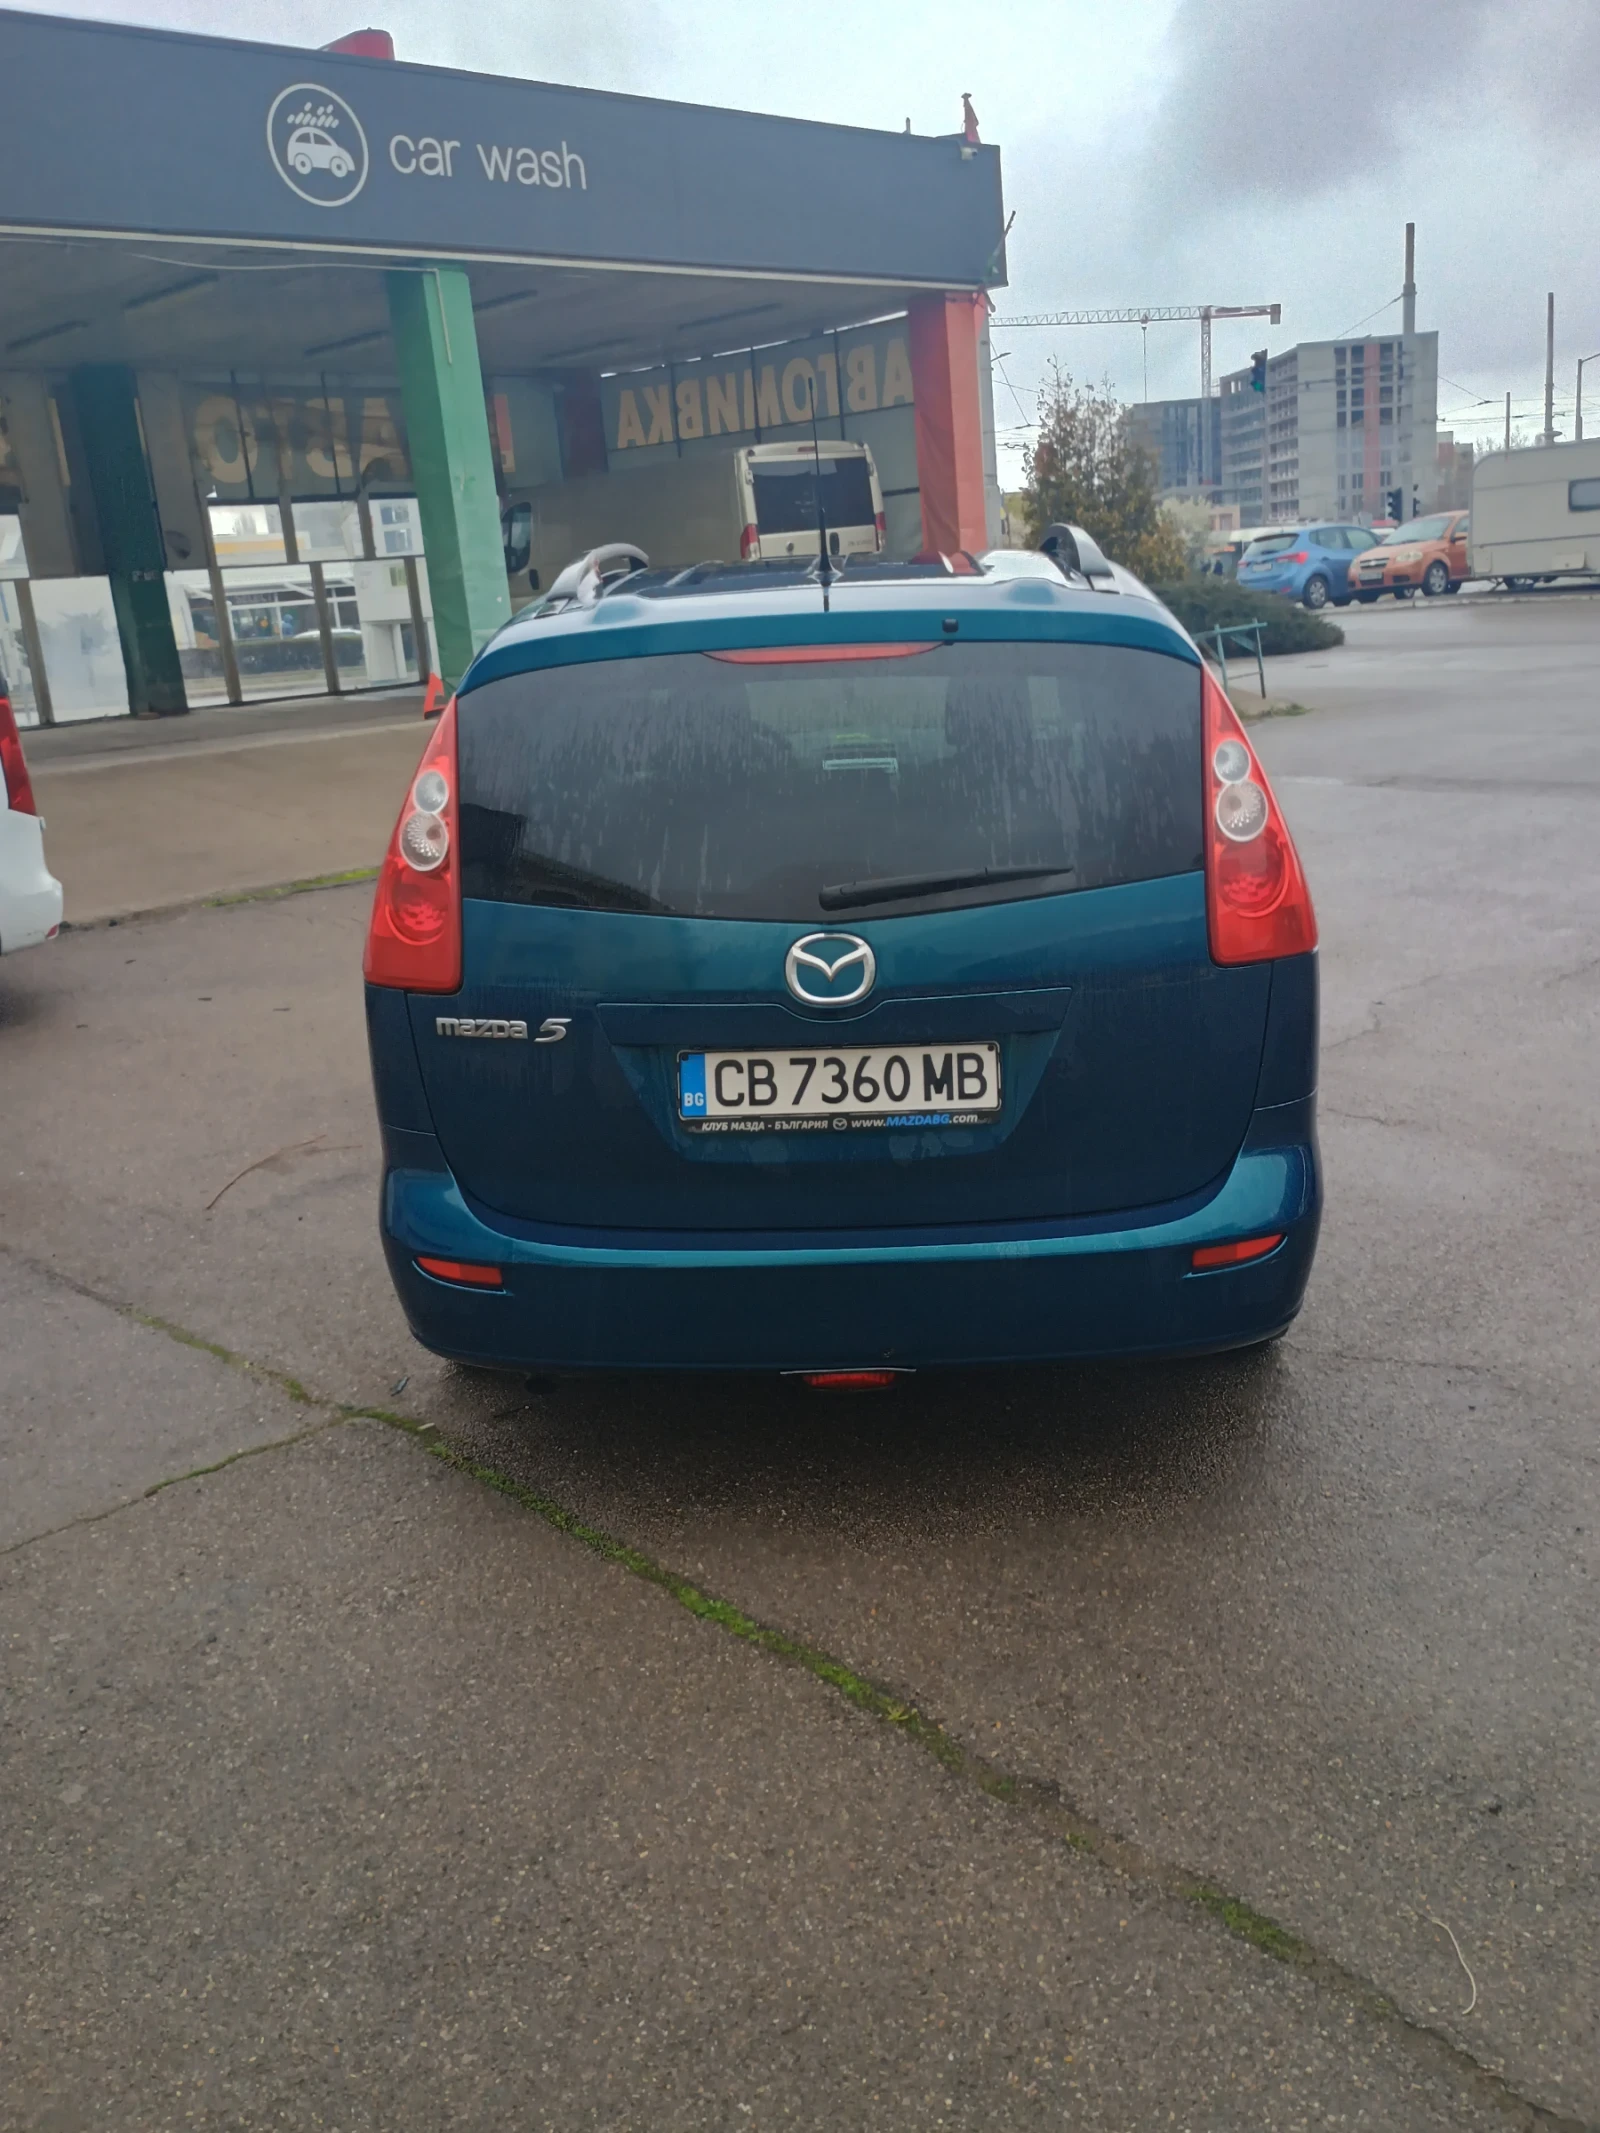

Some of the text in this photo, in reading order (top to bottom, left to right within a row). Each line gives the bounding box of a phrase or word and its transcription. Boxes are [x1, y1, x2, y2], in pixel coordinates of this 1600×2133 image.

[389, 134, 588, 190] car wash
[435, 1017, 573, 1042] mazda 5
[714, 1053, 988, 1106] CB 7360 MB
[683, 1092, 704, 1107] BG
[702, 1121, 729, 1132] КЛУБ
[730, 1121, 765, 1132] МАЗДА
[774, 1120, 828, 1130] БЪЛГАРИЯ
[851, 1113, 978, 1128] www.MAZDABG.com
